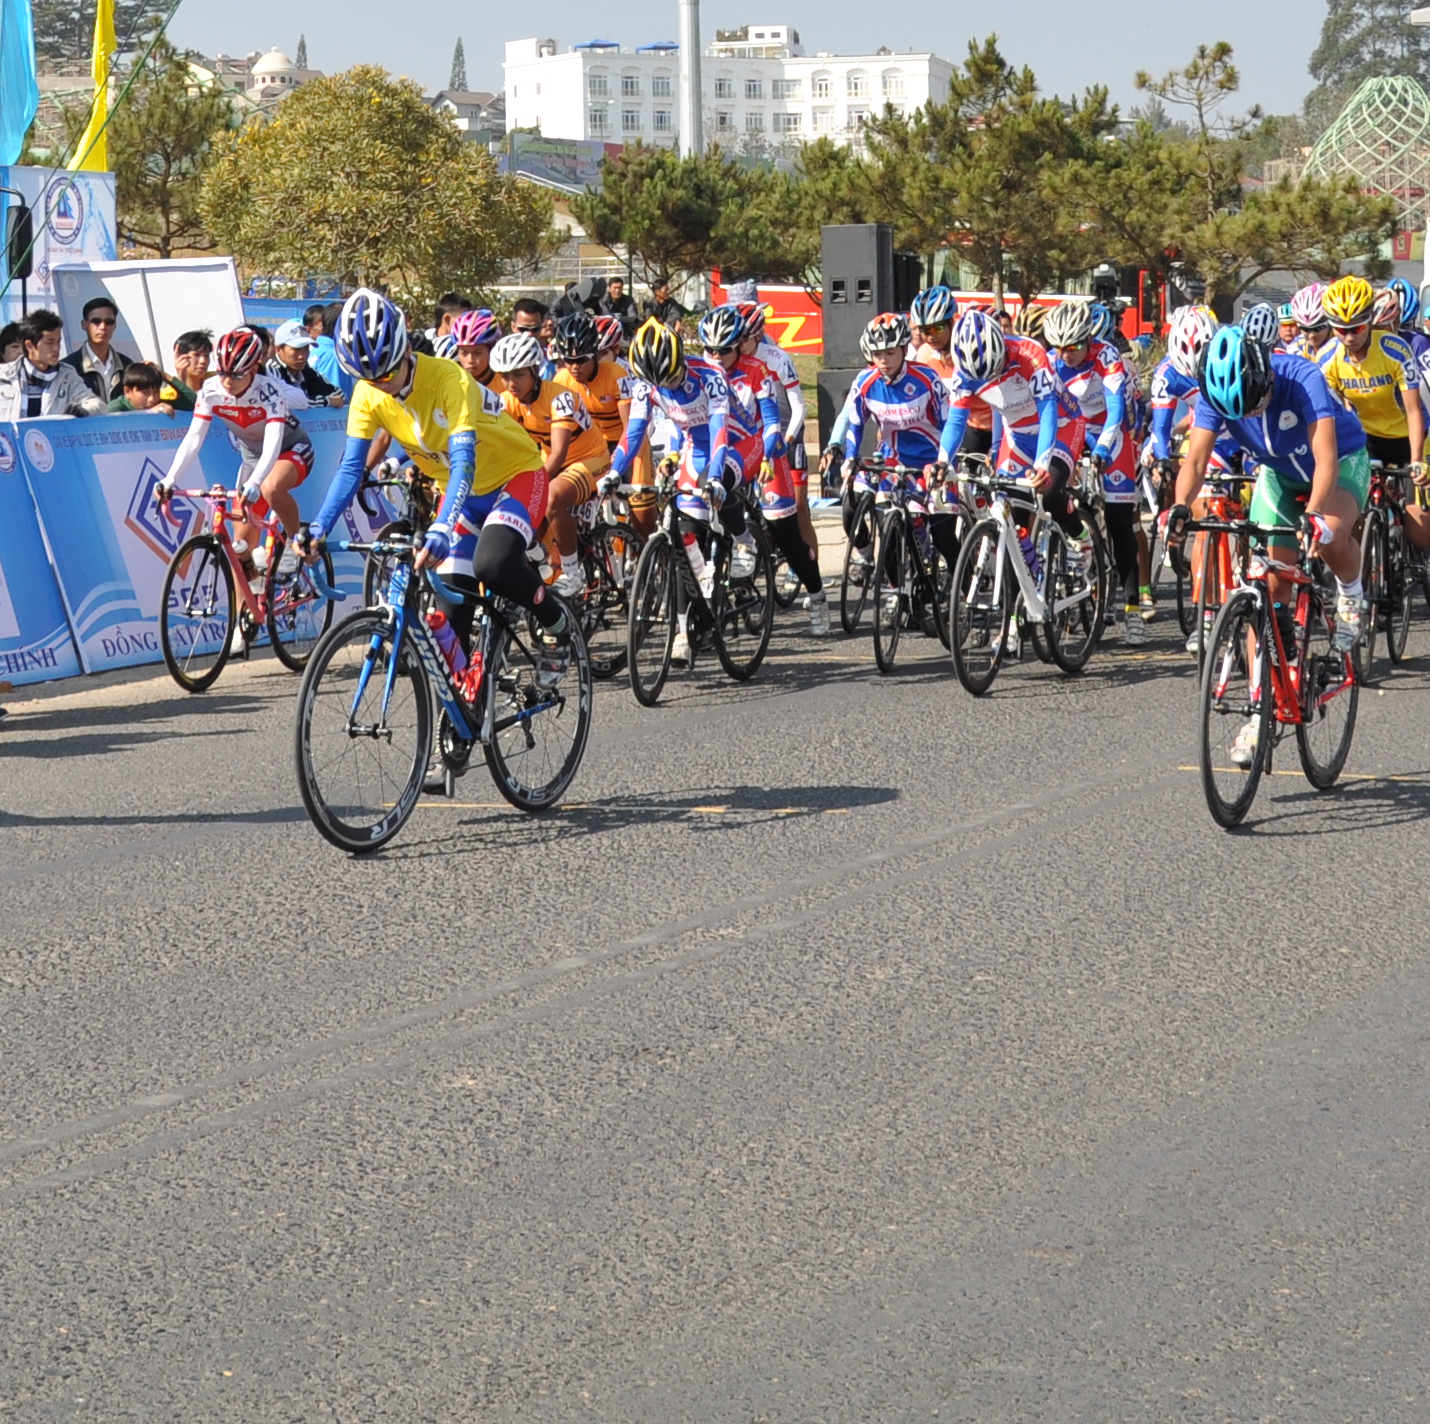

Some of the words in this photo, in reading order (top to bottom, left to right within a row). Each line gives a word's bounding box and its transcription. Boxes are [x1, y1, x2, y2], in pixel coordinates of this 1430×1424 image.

[1099, 345, 1120, 366] 23
[259, 382, 279, 403] 44
[707, 377, 727, 399] 28
[1031, 370, 1052, 394] 24
[555, 393, 574, 414] 46
[878, 406, 920, 416] DOMESCO
[579, 505, 592, 519] 46
[101, 626, 158, 657] ĐỒNG
